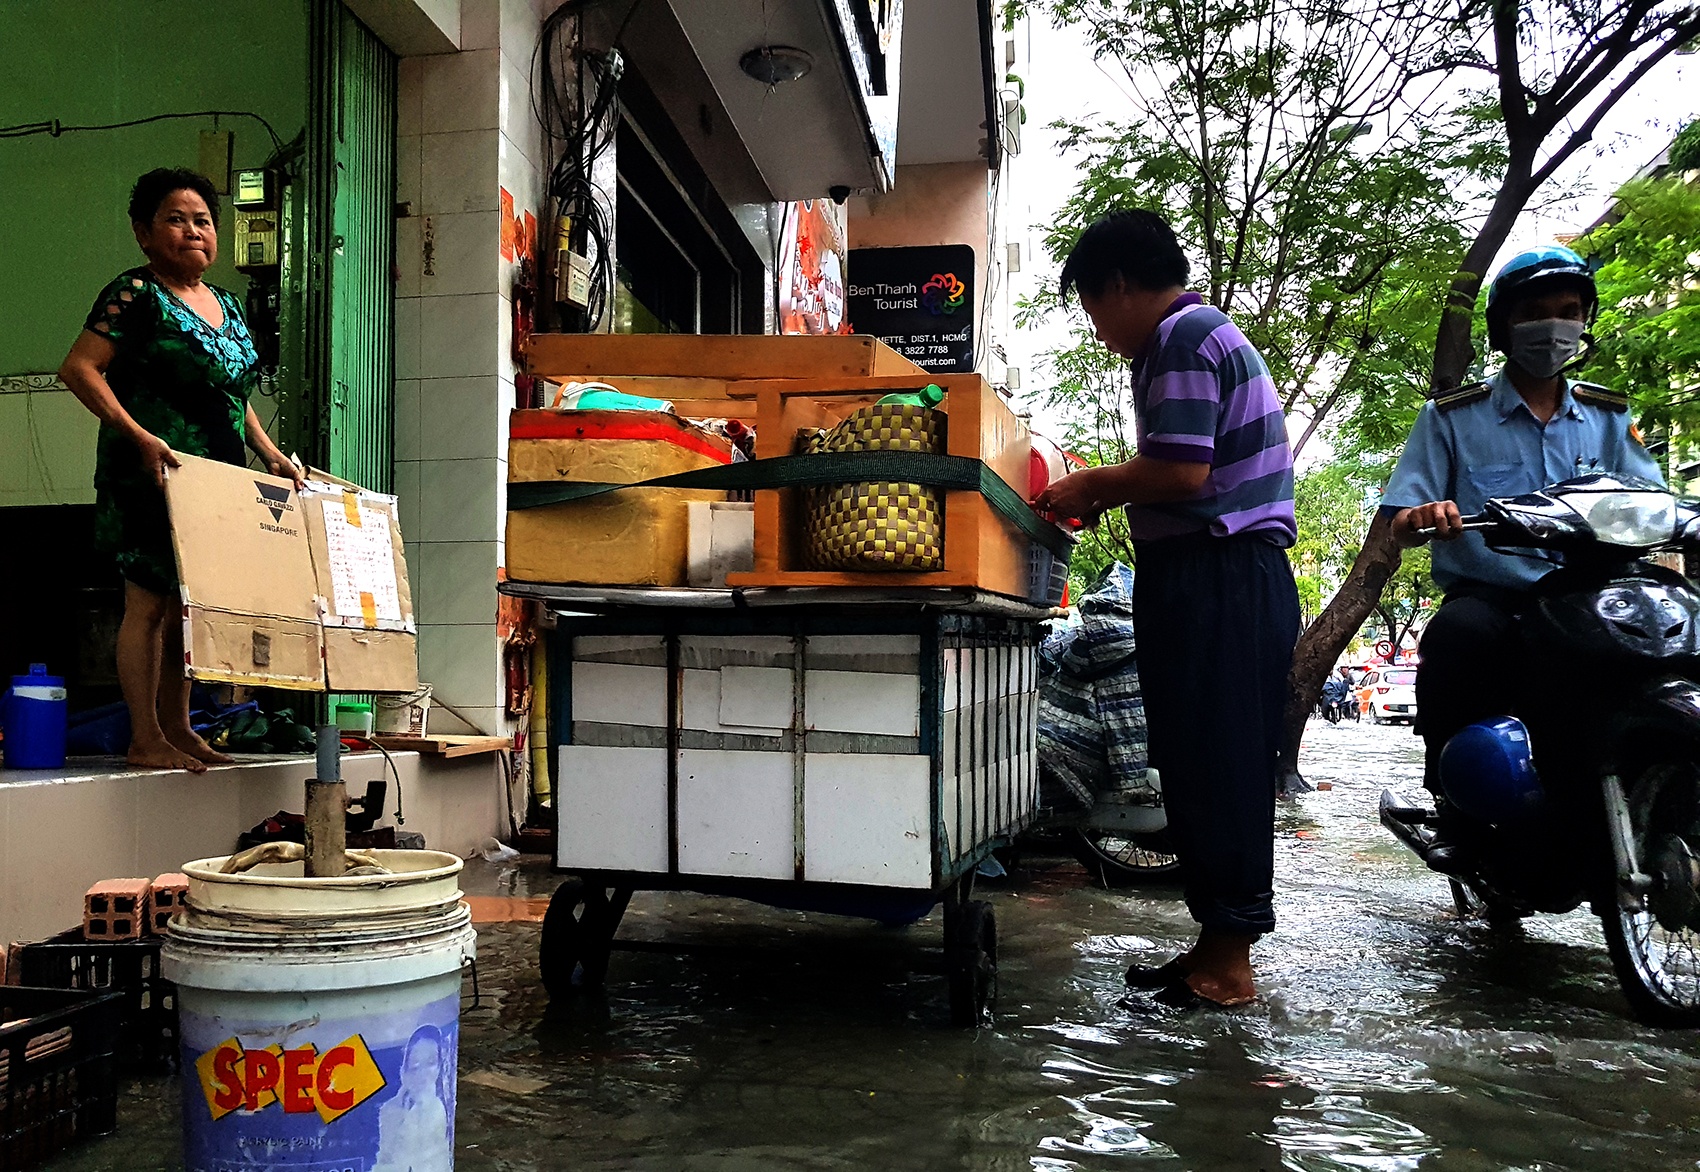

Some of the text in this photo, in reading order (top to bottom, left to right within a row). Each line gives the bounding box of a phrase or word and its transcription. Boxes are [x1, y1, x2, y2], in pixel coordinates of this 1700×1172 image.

[849, 283, 917, 296] Ben Thanh
[873, 298, 918, 310] Tourist
[942, 333, 967, 342] HCMC
[904, 346, 925, 355] 3822
[928, 345, 949, 354] 7788
[260, 522, 298, 537] SINGAPORE
[213, 1046, 355, 1113] SPEC
